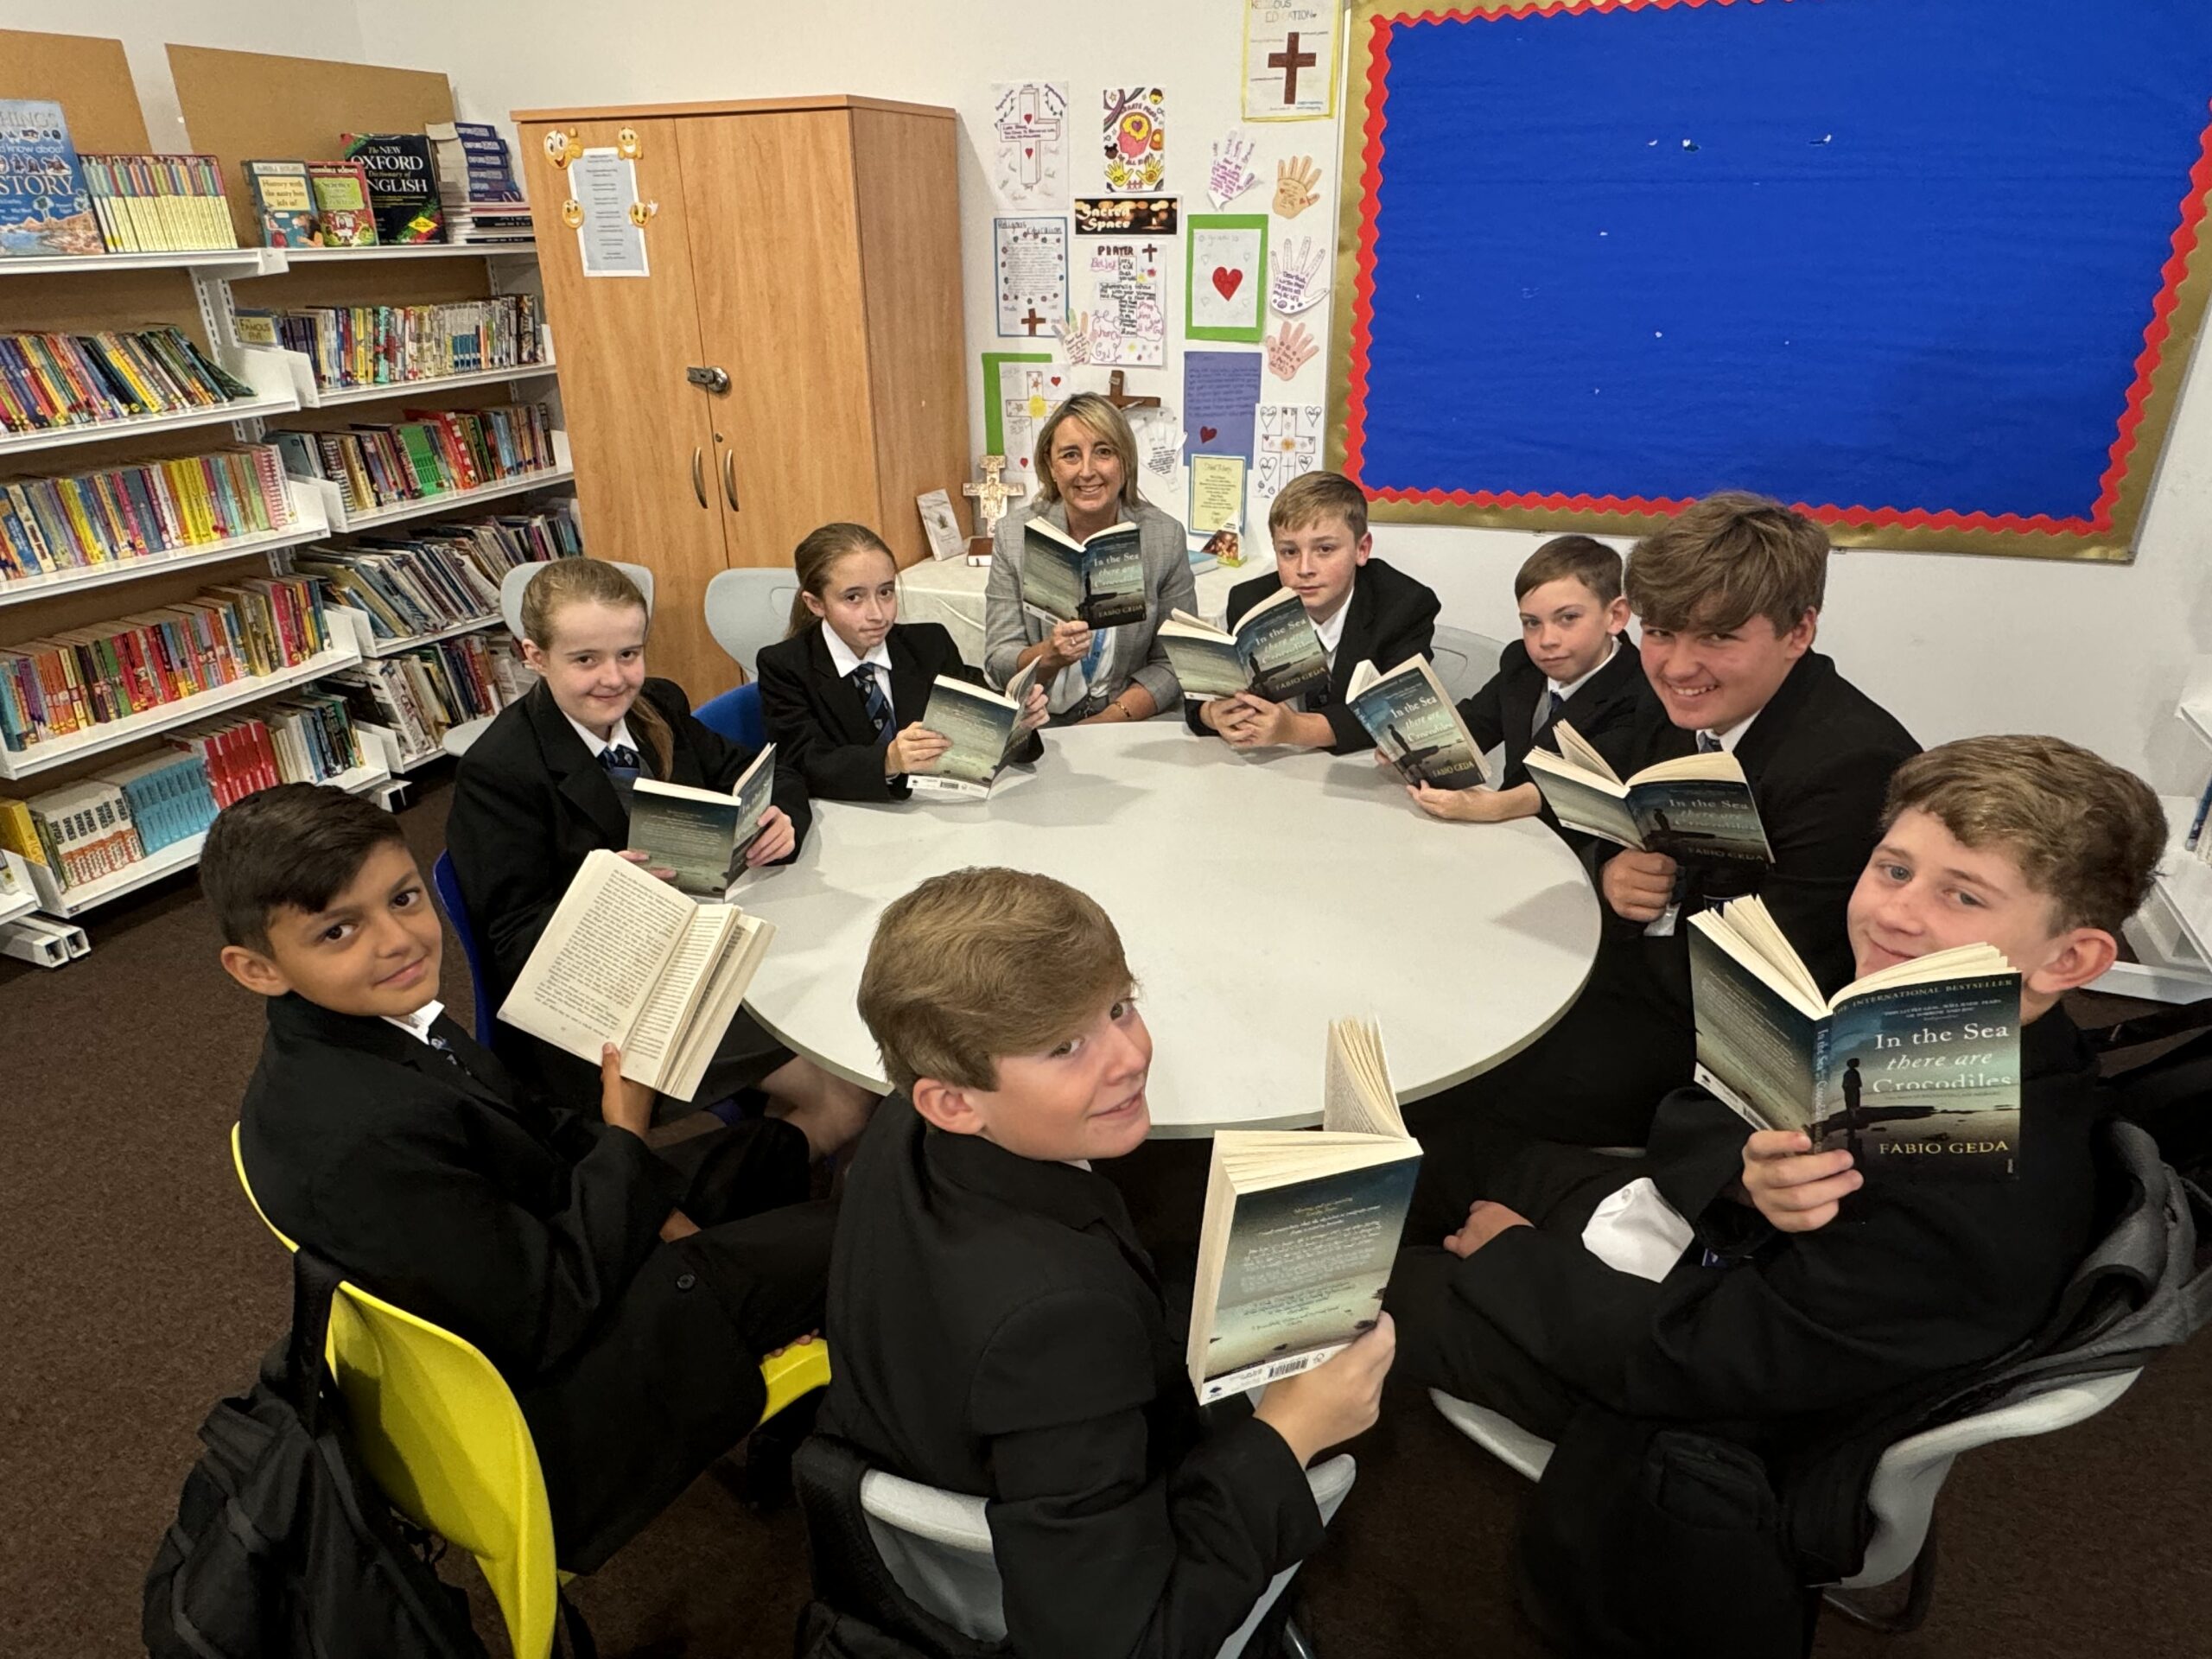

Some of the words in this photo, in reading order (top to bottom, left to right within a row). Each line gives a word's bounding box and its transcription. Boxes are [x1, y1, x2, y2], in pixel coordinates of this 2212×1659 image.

[351, 156, 423, 170] OXFORD
[366, 179, 428, 192] NGLISH
[1076, 203, 1129, 220] Sacred
[1081, 218, 1131, 232] Space
[1107, 555, 1121, 563] the
[1124, 552, 1140, 562] Sea
[1255, 638, 1267, 646] In
[1269, 627, 1286, 638] the
[1288, 620, 1306, 630] Sea
[1265, 641, 1287, 653] there
[1276, 678, 1300, 690] FABIO
[1302, 667, 1326, 680] GEDA
[1390, 709, 1403, 719] In
[1405, 703, 1420, 715] the
[1420, 696, 1438, 707] Sea
[1406, 718, 1426, 730] there
[1428, 712, 1440, 721] are
[1455, 761, 1475, 772] GEDA
[1669, 799, 1685, 808] In
[1691, 799, 1716, 808] the
[1721, 799, 1749, 809] Sea
[1681, 810, 1716, 819] there
[1688, 847, 1725, 857] FABIO
[1728, 852, 1764, 861] GEDA
[1853, 987, 1940, 1006] INTERNATIONAL
[1946, 979, 2012, 992] BESTSELLER
[1875, 1034, 1902, 1050] In
[1912, 1028, 1953, 1045] the
[1963, 1022, 2011, 1040] Sea
[1815, 1055, 1827, 1071] Sea
[1886, 1053, 1950, 1071] there
[1955, 1052, 1993, 1065] are
[1873, 1072, 2012, 1094] Crocodiles
[1879, 1143, 1942, 1154] FABIO
[1949, 1140, 2009, 1154] GEDA
